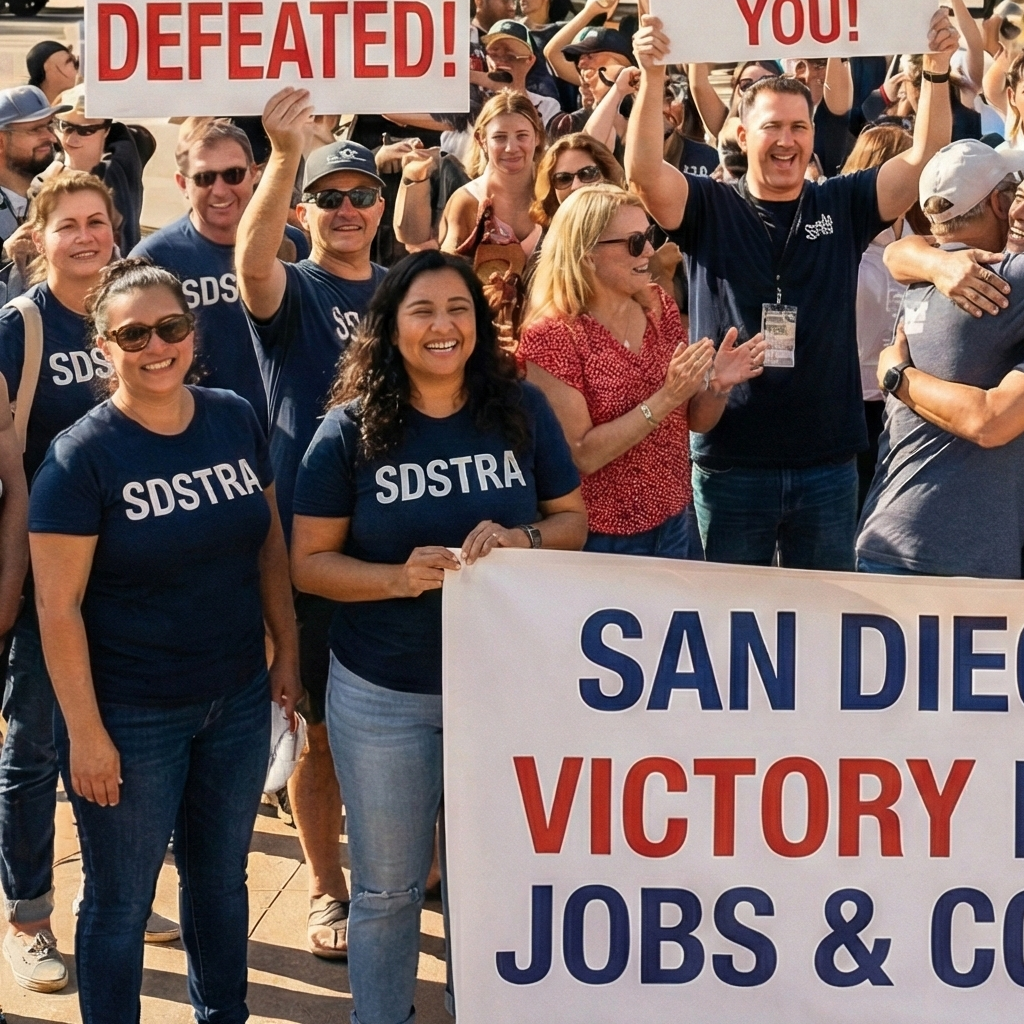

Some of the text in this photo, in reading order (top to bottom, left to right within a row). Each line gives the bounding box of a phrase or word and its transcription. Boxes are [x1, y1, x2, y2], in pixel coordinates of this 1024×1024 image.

[97, 0, 456, 82] DEFEATED!
[122, 459, 263, 521] SDSTRA
[375, 450, 527, 505] SDSTRA
[579, 608, 796, 712] SAN
[513, 755, 976, 858] VICTORY
[495, 884, 778, 988] JOBS
[814, 888, 895, 988] &
